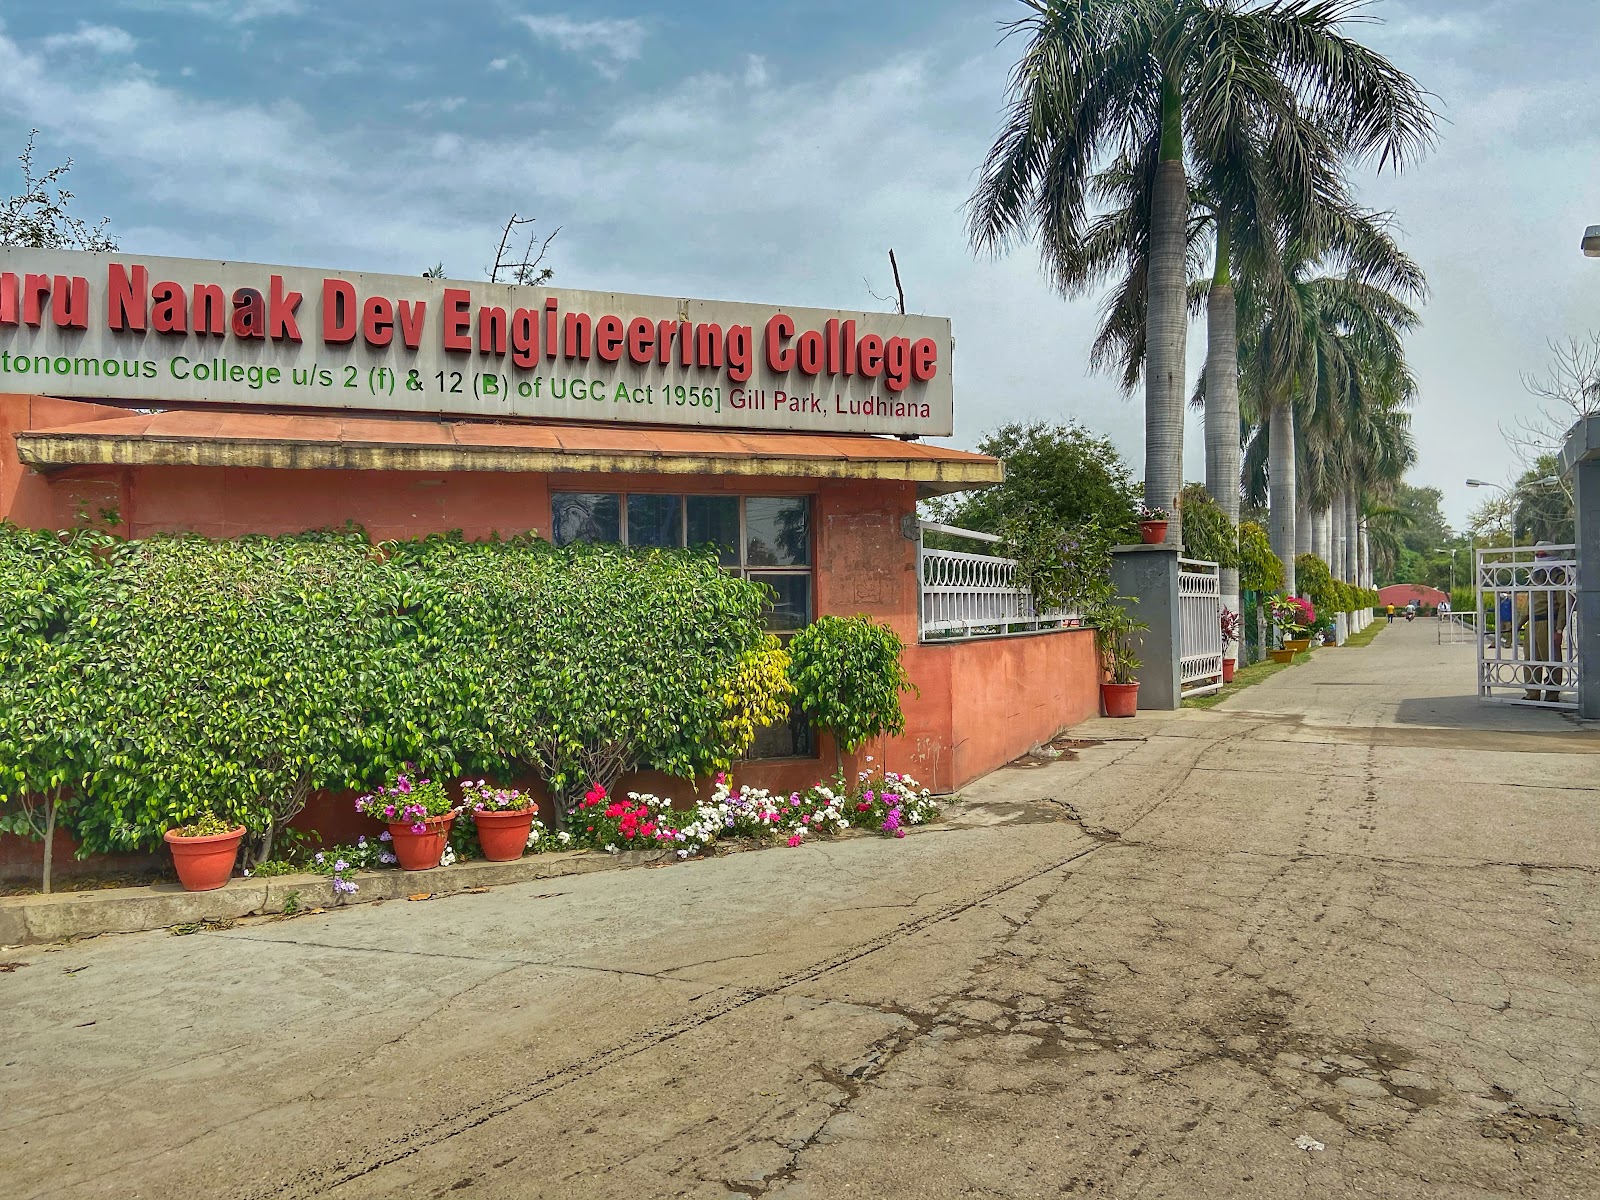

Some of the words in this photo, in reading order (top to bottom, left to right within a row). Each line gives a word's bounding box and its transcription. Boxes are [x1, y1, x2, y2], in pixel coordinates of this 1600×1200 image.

[108, 264, 303, 343] Nanak
[323, 279, 426, 350] Dev
[444, 289, 752, 382] Engineering
[766, 314, 937, 392] College
[2, 350, 158, 379] tonomous
[170, 356, 281, 389] College
[292, 363, 333, 388] u/s
[343, 364, 358, 389] 2
[368, 367, 396, 396] (f)
[405, 370, 424, 392] &
[435, 370, 463, 394] 12
[473, 373, 508, 401] (B)
[518, 378, 541, 398] of
[550, 379, 606, 402] UGC
[613, 383, 654, 405] Act
[663, 384, 721, 414] 1956]
[729, 388, 766, 411] Gill
[774, 391, 828, 417] Park,
[836, 394, 931, 418] Ludhiana
